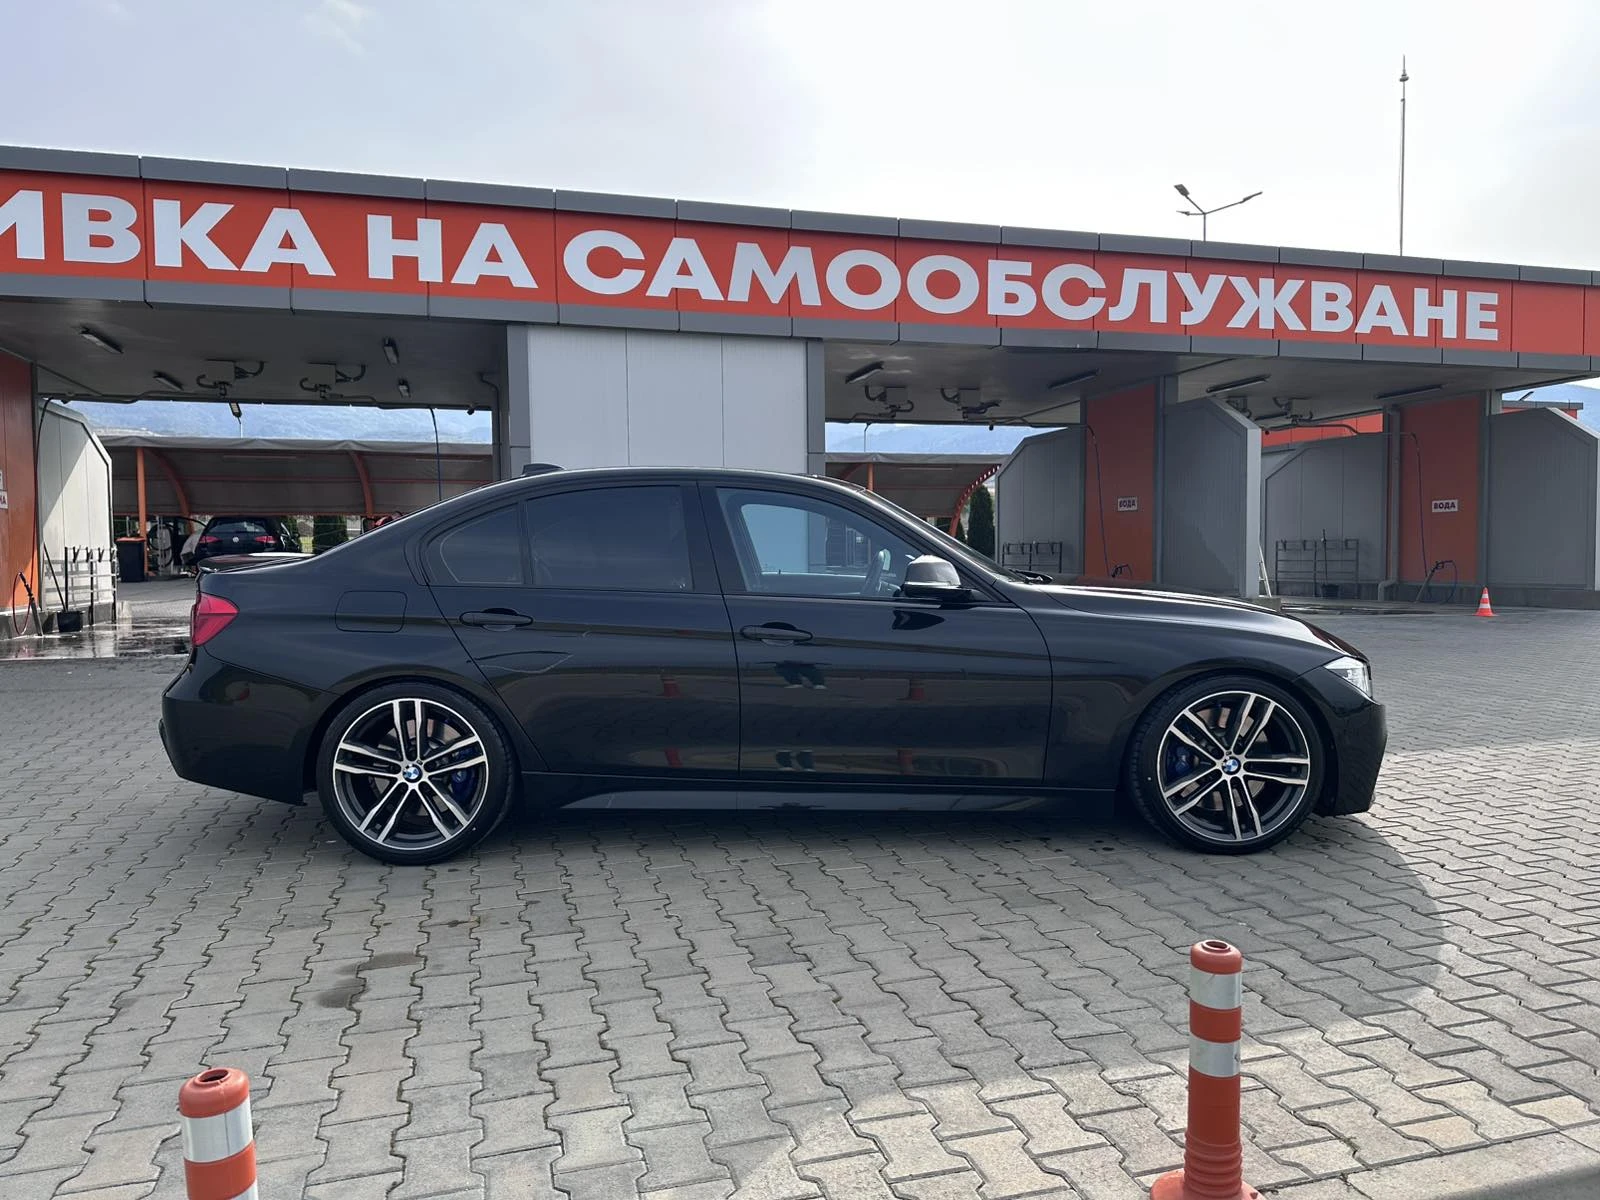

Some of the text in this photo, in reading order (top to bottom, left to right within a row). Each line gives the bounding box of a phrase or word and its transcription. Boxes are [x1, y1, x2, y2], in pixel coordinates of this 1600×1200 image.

[368, 214, 539, 289] НА
[563, 229, 1499, 342] САМООБСЛУЖВАНЕ
[1433, 502, 1456, 510] ВОДА
